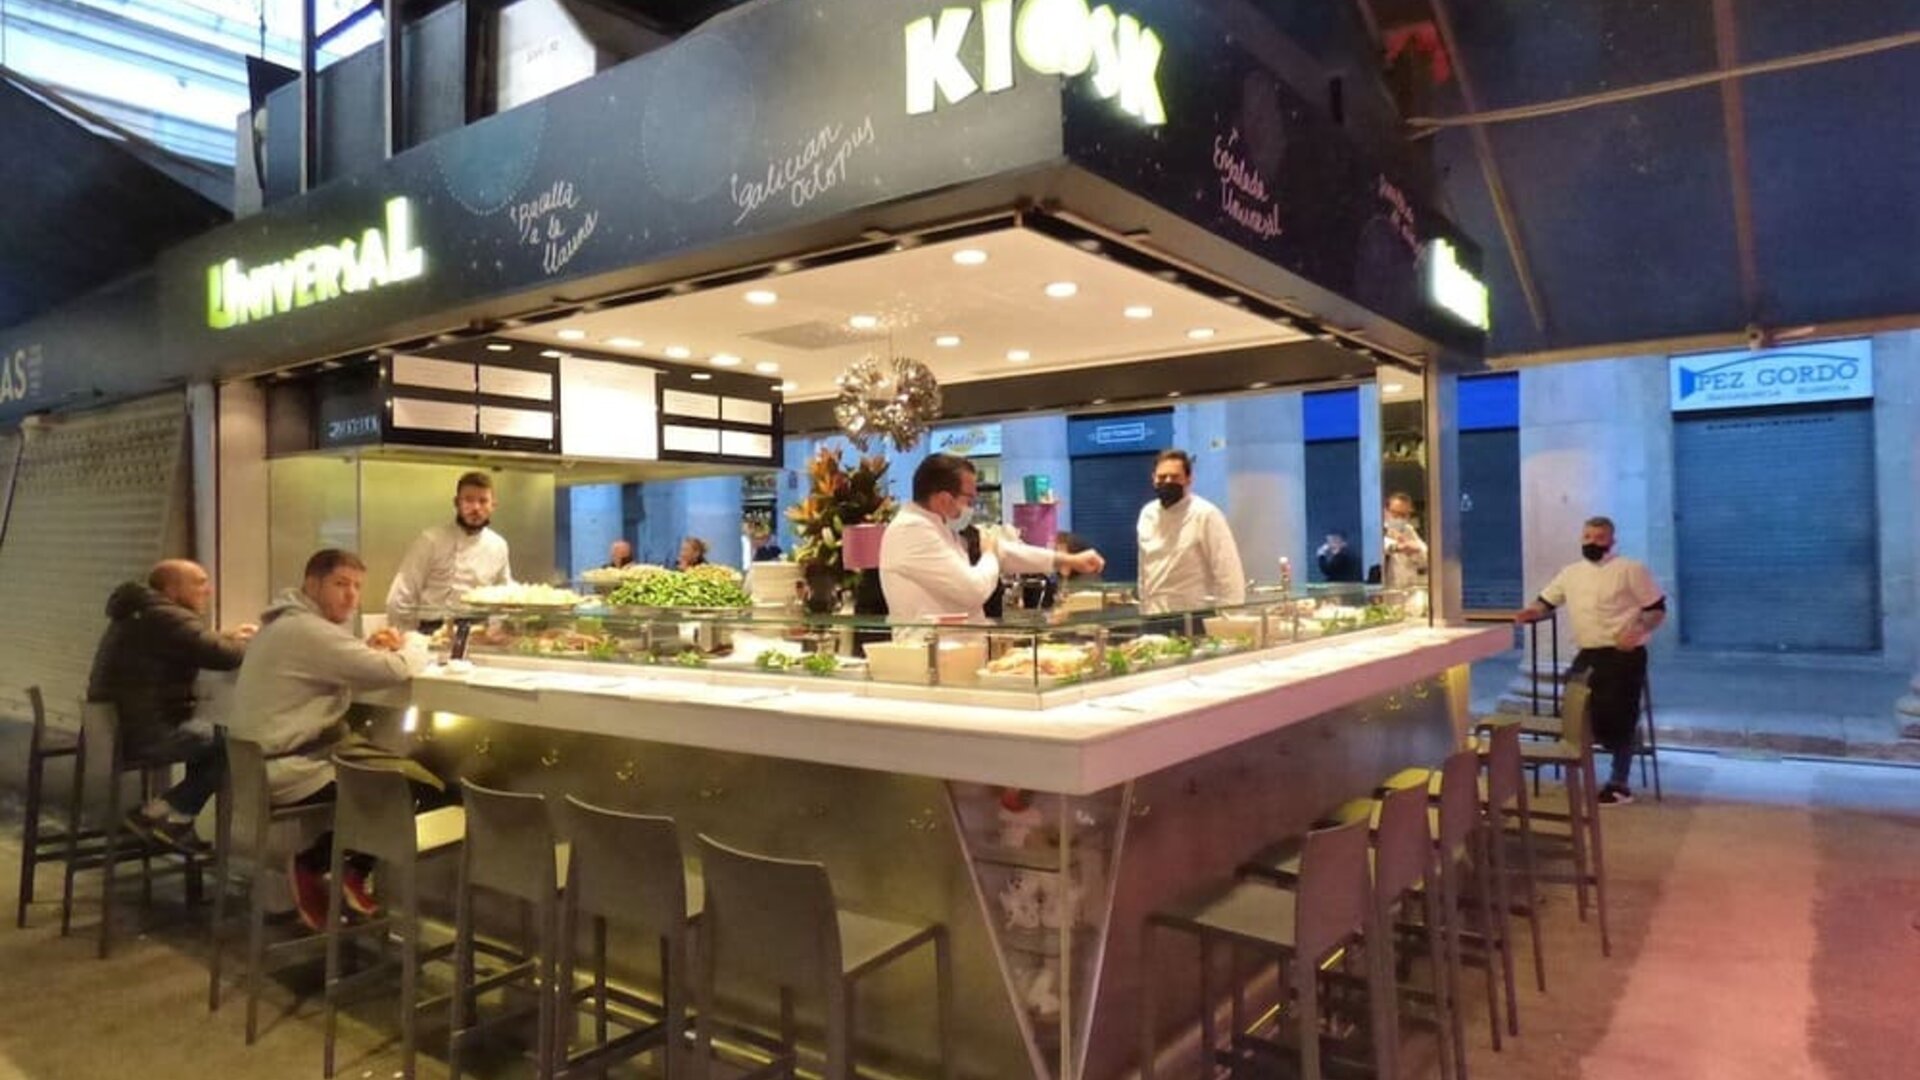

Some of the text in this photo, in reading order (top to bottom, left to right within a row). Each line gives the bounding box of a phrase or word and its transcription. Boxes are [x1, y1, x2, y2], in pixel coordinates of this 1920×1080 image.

[905, 0, 1167, 125] KIOSK
[1697, 361, 1859, 391] PEZ GORDO
